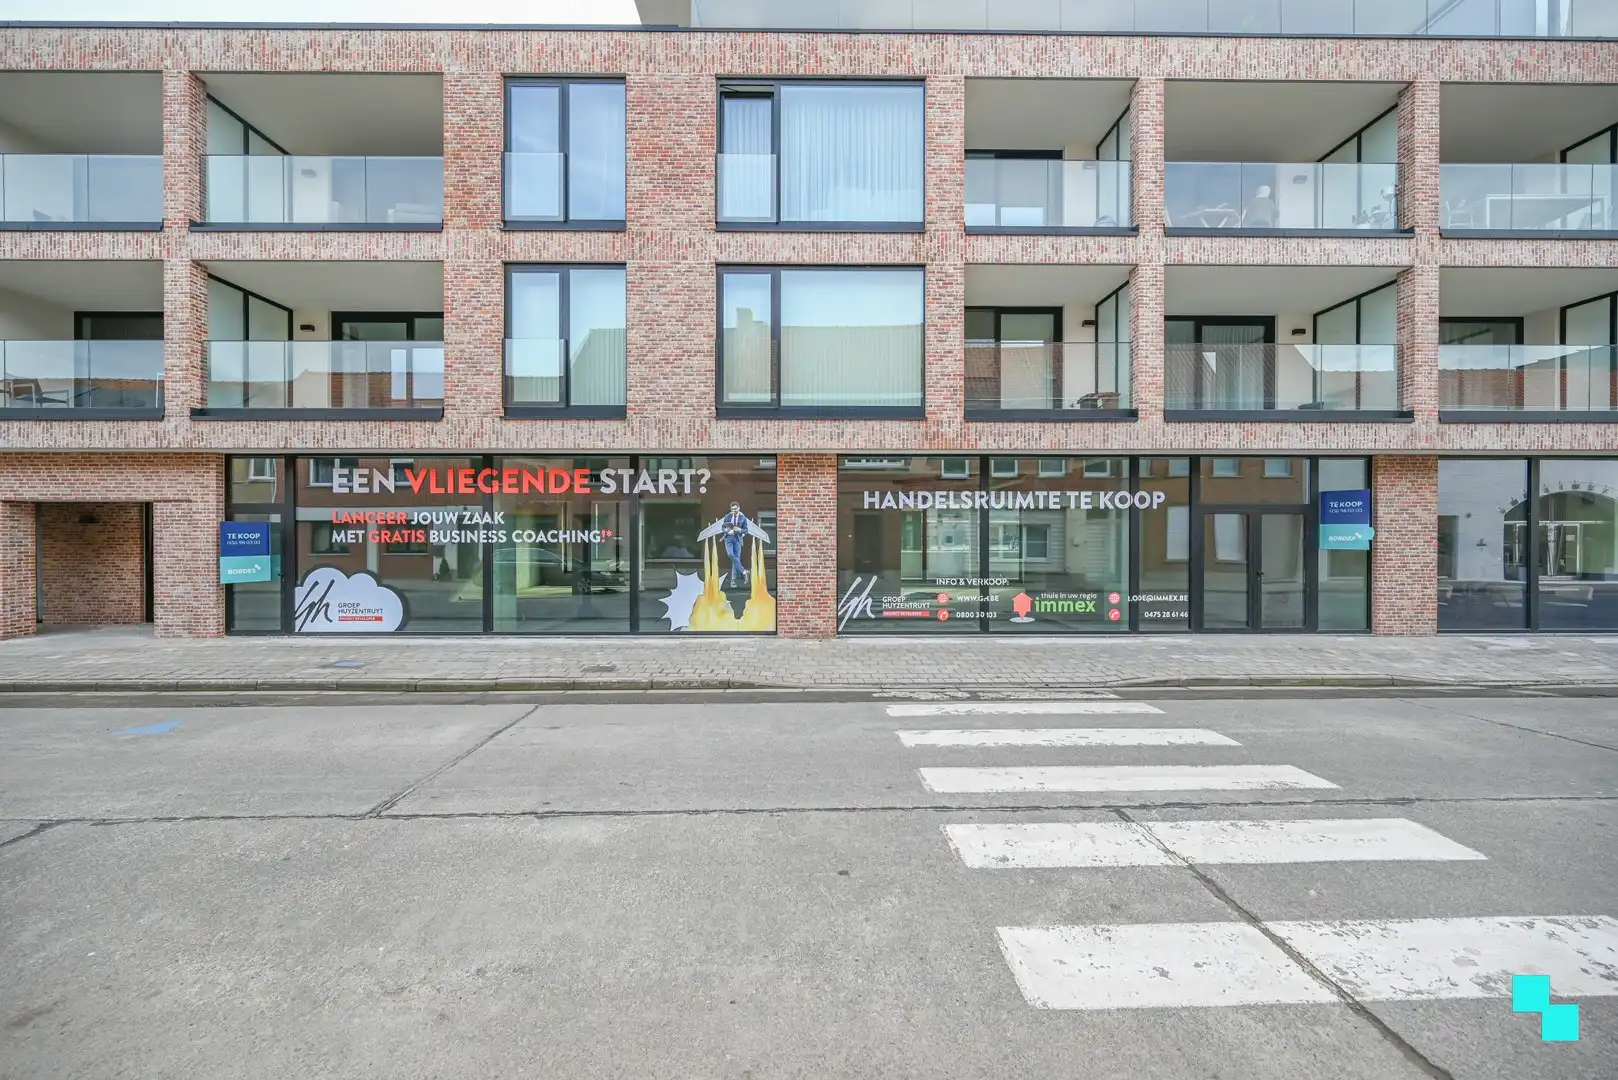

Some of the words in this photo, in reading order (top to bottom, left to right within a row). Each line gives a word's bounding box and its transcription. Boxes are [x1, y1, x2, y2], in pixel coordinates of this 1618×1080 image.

[332, 468, 396, 495] EEN
[404, 468, 592, 495] VLIEGENDE
[599, 468, 712, 495] START?
[863, 491, 1061, 510] HANDELSRUIMTE
[1066, 491, 1093, 510] TE
[1100, 491, 1166, 510] KOOP
[332, 511, 408, 526] LANCEER
[411, 511, 459, 525] JOUW
[462, 511, 506, 525] ZAAK
[331, 529, 366, 544] MET
[368, 529, 426, 544] GRATIS
[429, 529, 507, 544] BUSINESS
[936, 578, 957, 586] INFO
[959, 578, 965, 586] &
[967, 578, 1010, 586] VERKOOP:
[1079, 593, 1097, 601] regio
[1035, 597, 1096, 613] immex
